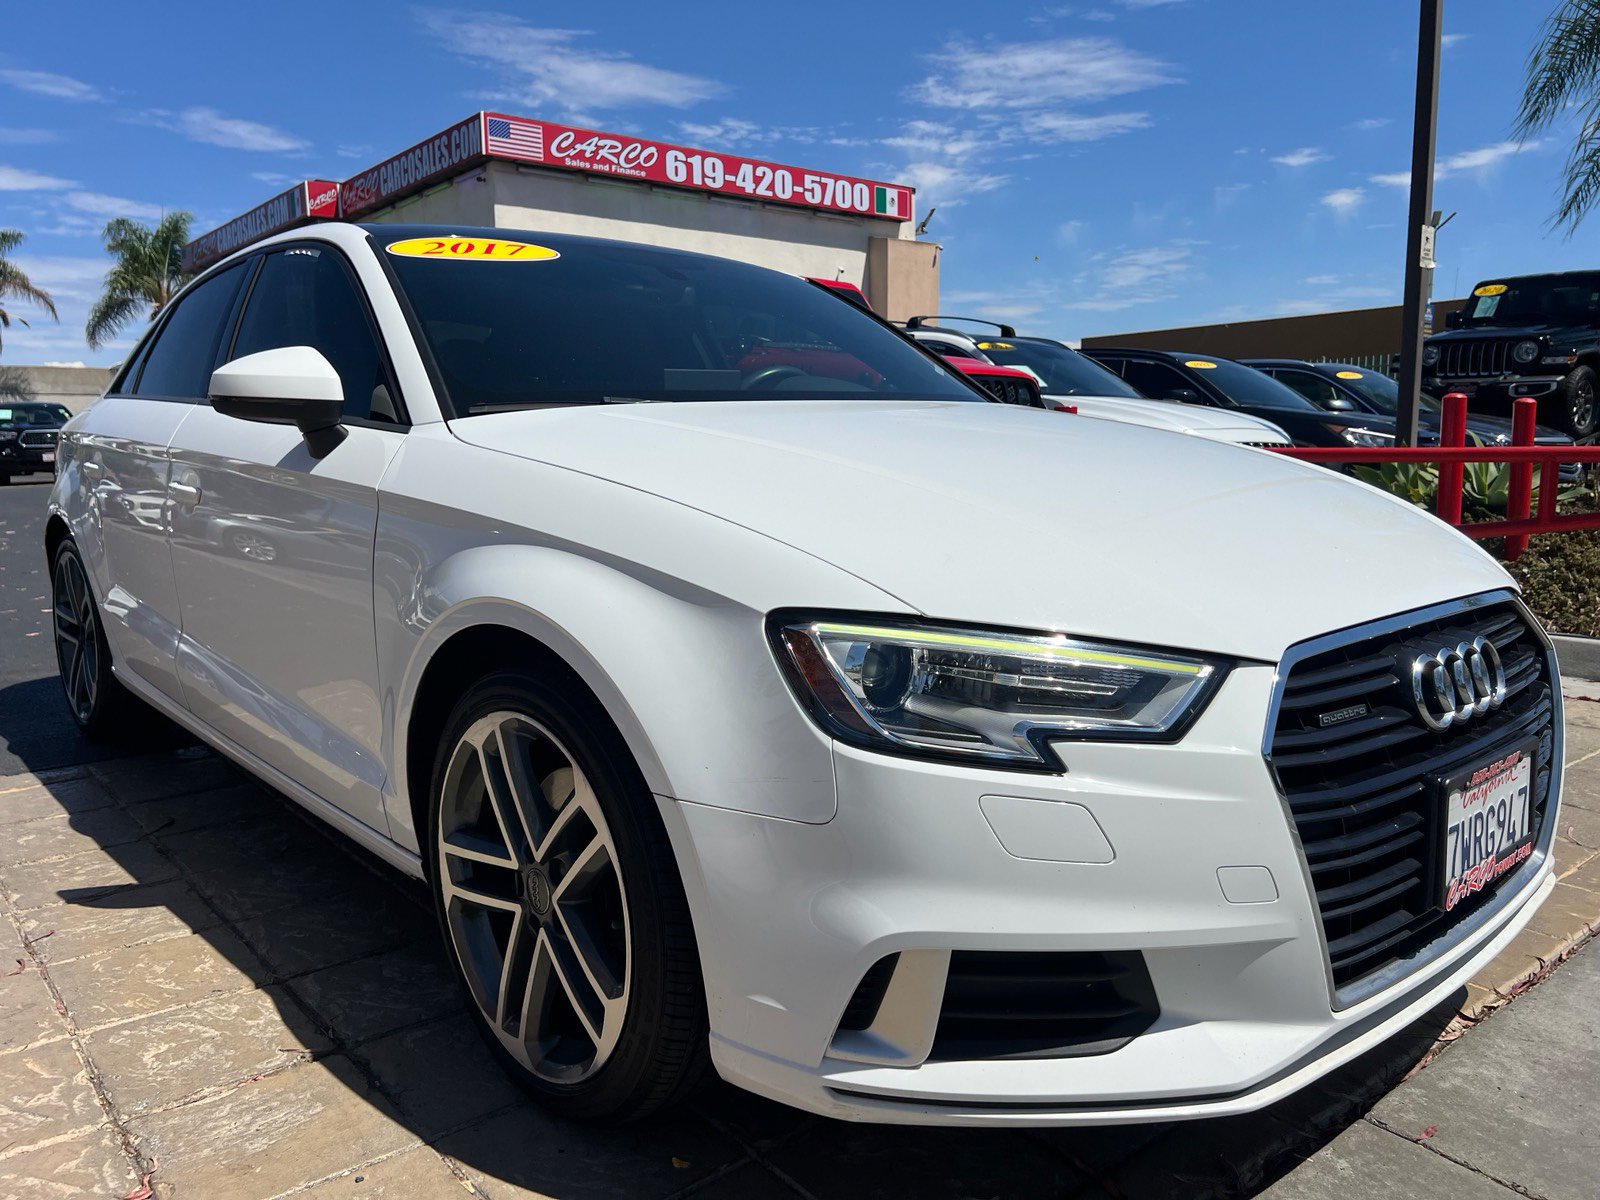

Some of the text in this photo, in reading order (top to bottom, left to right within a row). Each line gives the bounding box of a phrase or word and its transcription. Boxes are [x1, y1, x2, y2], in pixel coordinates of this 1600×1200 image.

[380, 119, 480, 197] CARCOSALES.COM
[550, 131, 658, 168] CARCO
[565, 157, 646, 177] Sales and Finance
[309, 188, 337, 209] CARCO
[665, 150, 870, 211] 619-420-5700
[217, 194, 289, 252] CARCOSALES.COM
[422, 241, 526, 256] 2017
[1322, 706, 1366, 724] quattro
[1448, 786, 1528, 878] 7WRG947
[1446, 855, 1496, 911] CARCO
